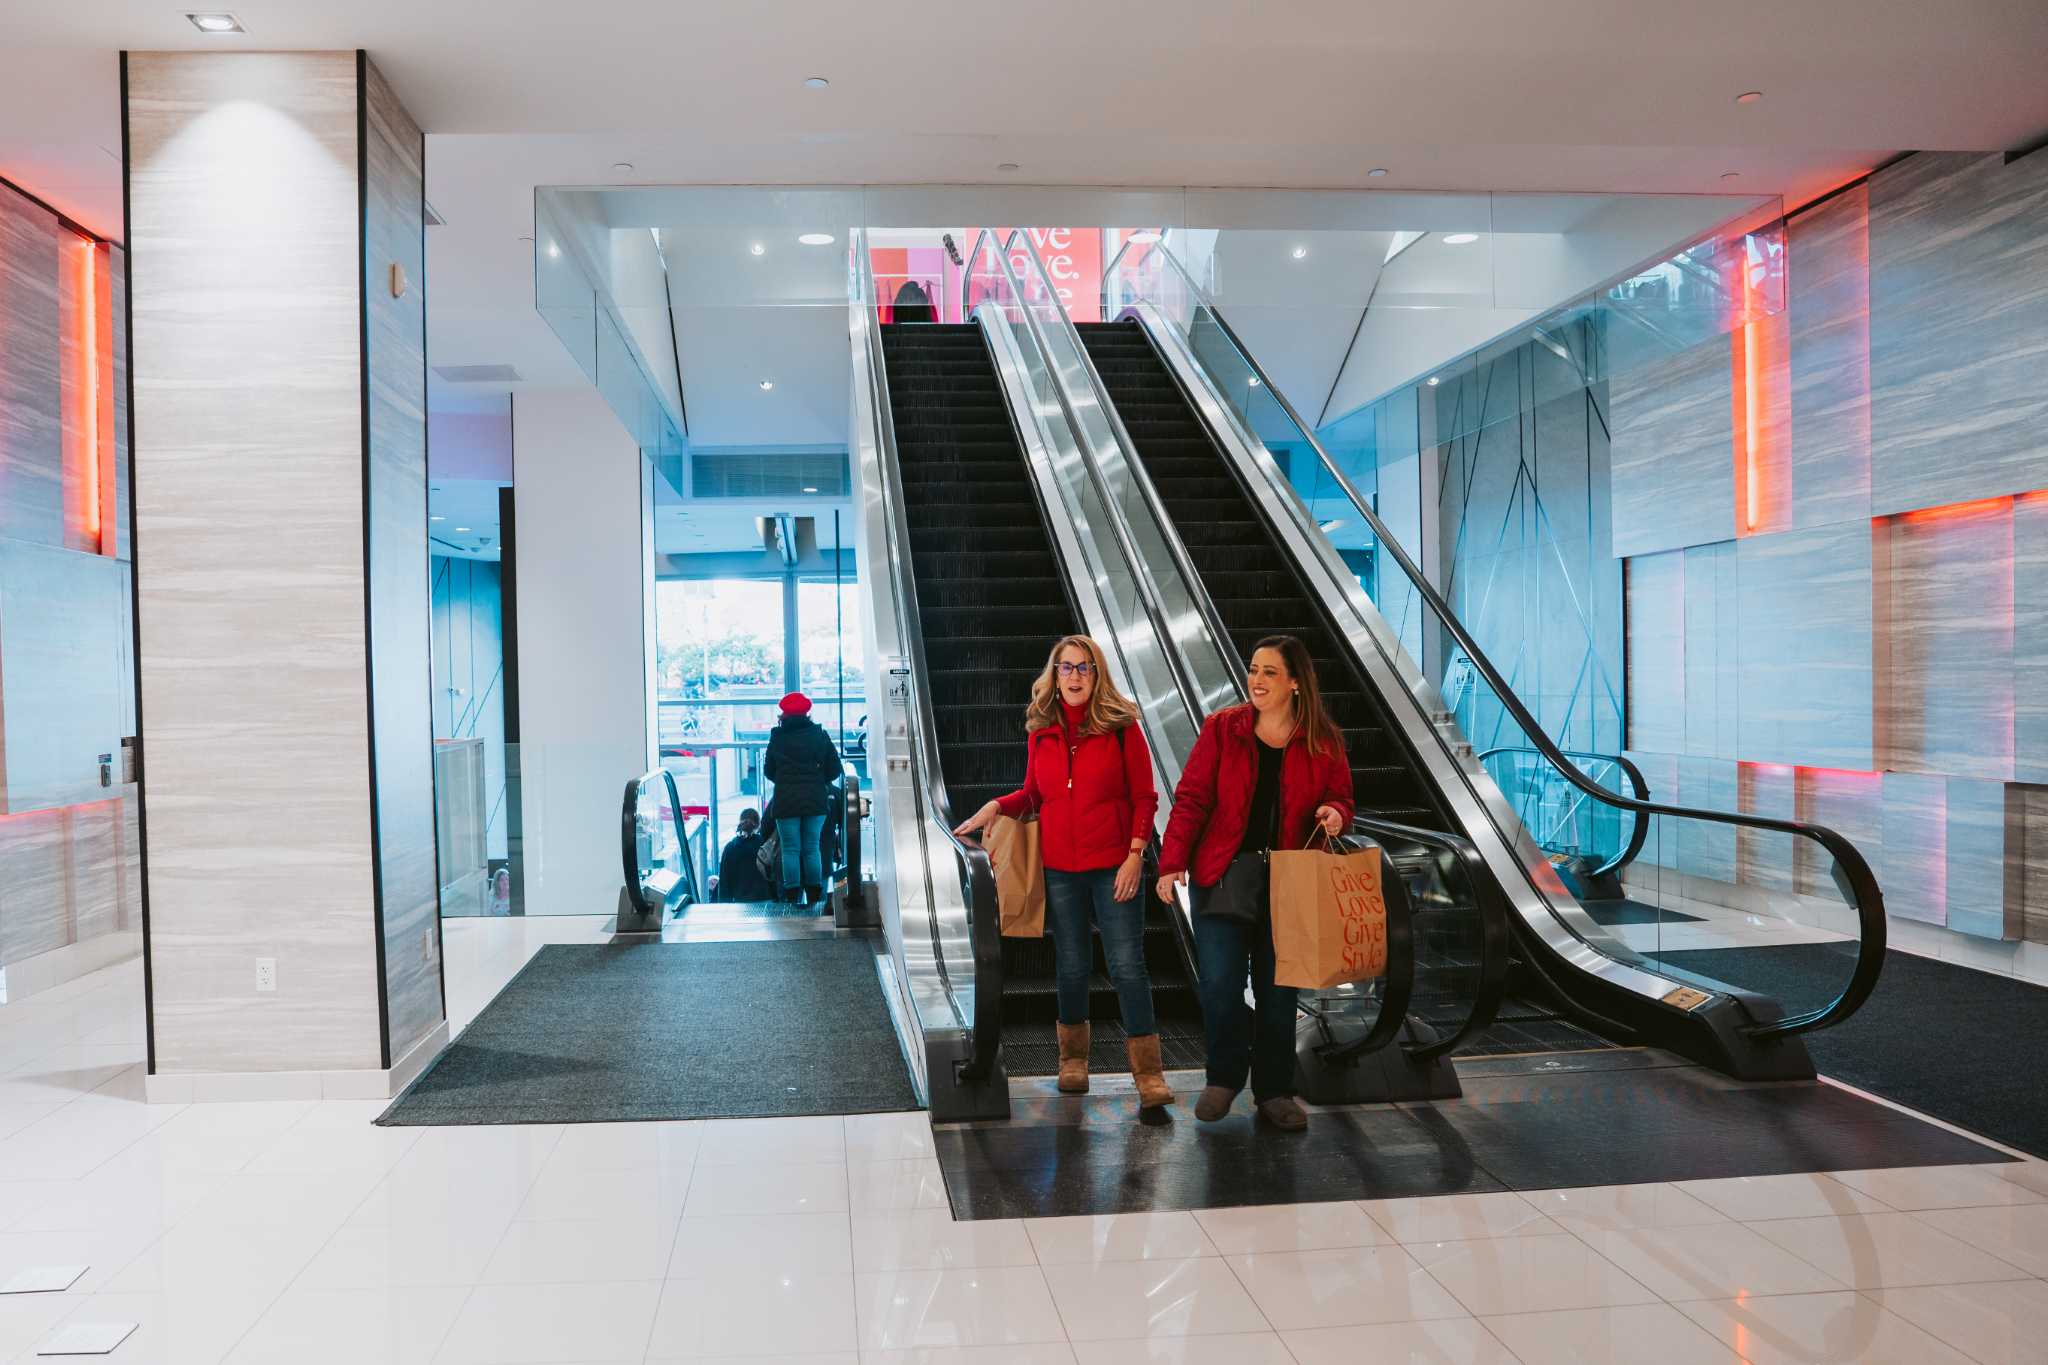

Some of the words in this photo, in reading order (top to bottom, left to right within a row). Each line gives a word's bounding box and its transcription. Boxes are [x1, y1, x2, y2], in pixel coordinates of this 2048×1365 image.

[1330, 865, 1375, 893] Give
[1334, 891, 1384, 918] Love
[1343, 917, 1384, 945] Give
[1341, 943, 1382, 973] Style
